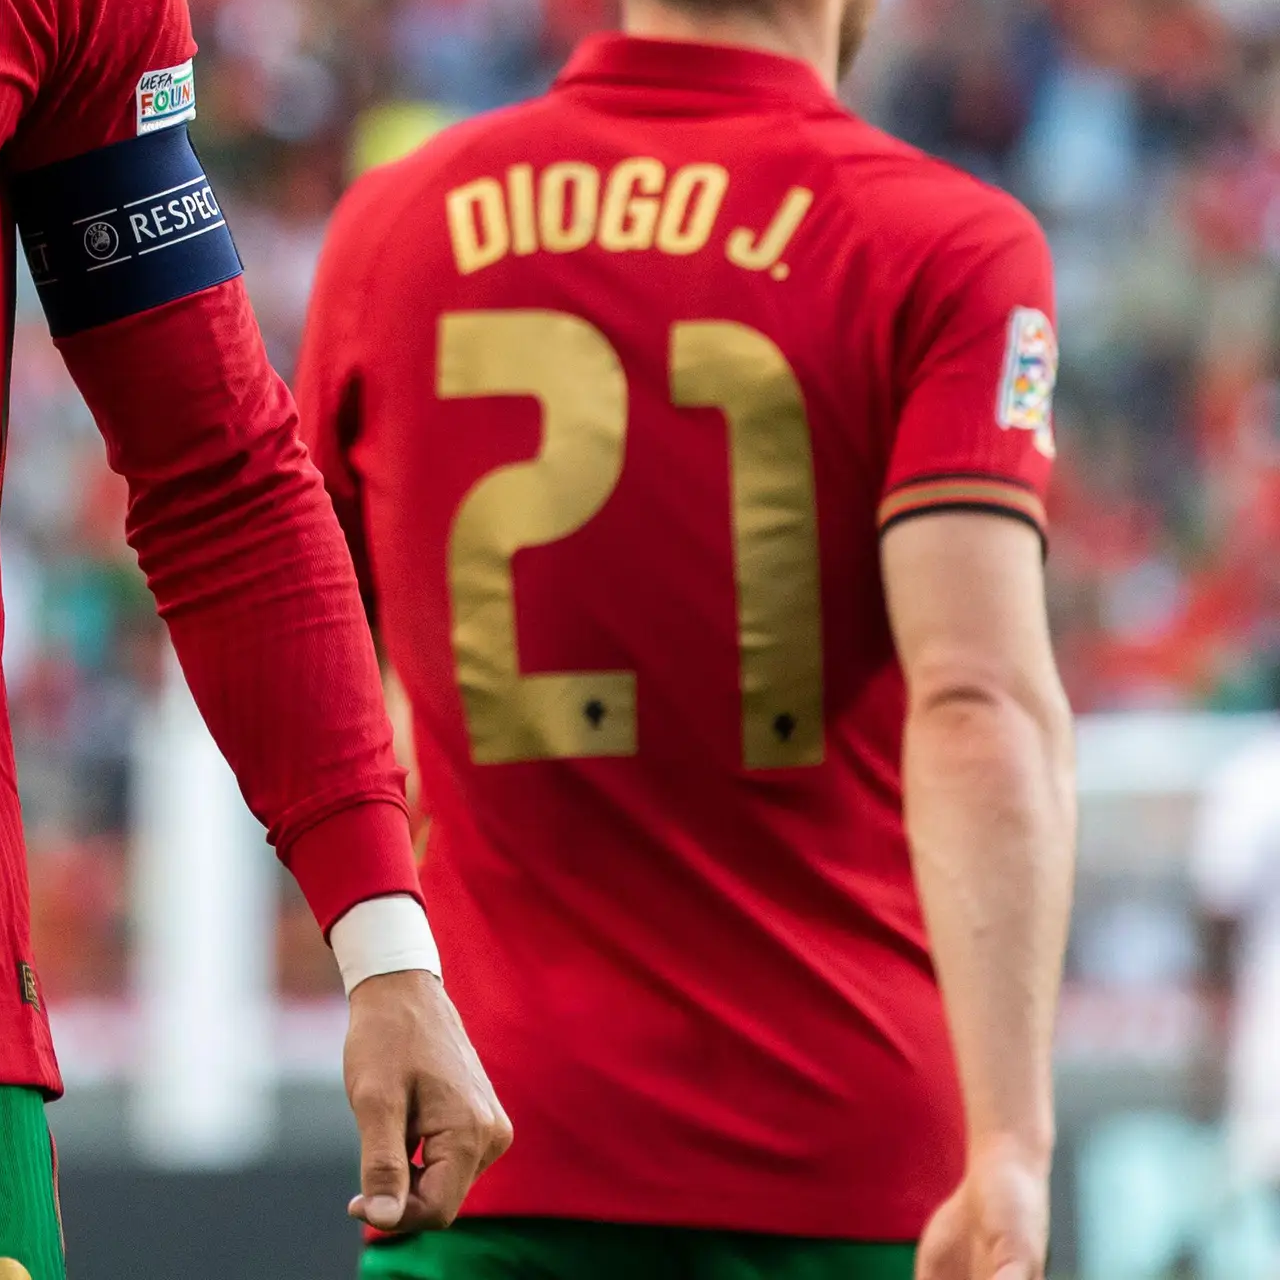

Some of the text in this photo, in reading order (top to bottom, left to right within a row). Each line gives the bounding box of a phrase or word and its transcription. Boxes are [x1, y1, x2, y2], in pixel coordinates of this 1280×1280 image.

[140, 73, 172, 91] UEFA
[141, 82, 194, 115] FOUN
[87, 223, 108, 237] UEFA
[444, 157, 813, 280] DIOGO J.
[435, 308, 826, 770] 21
